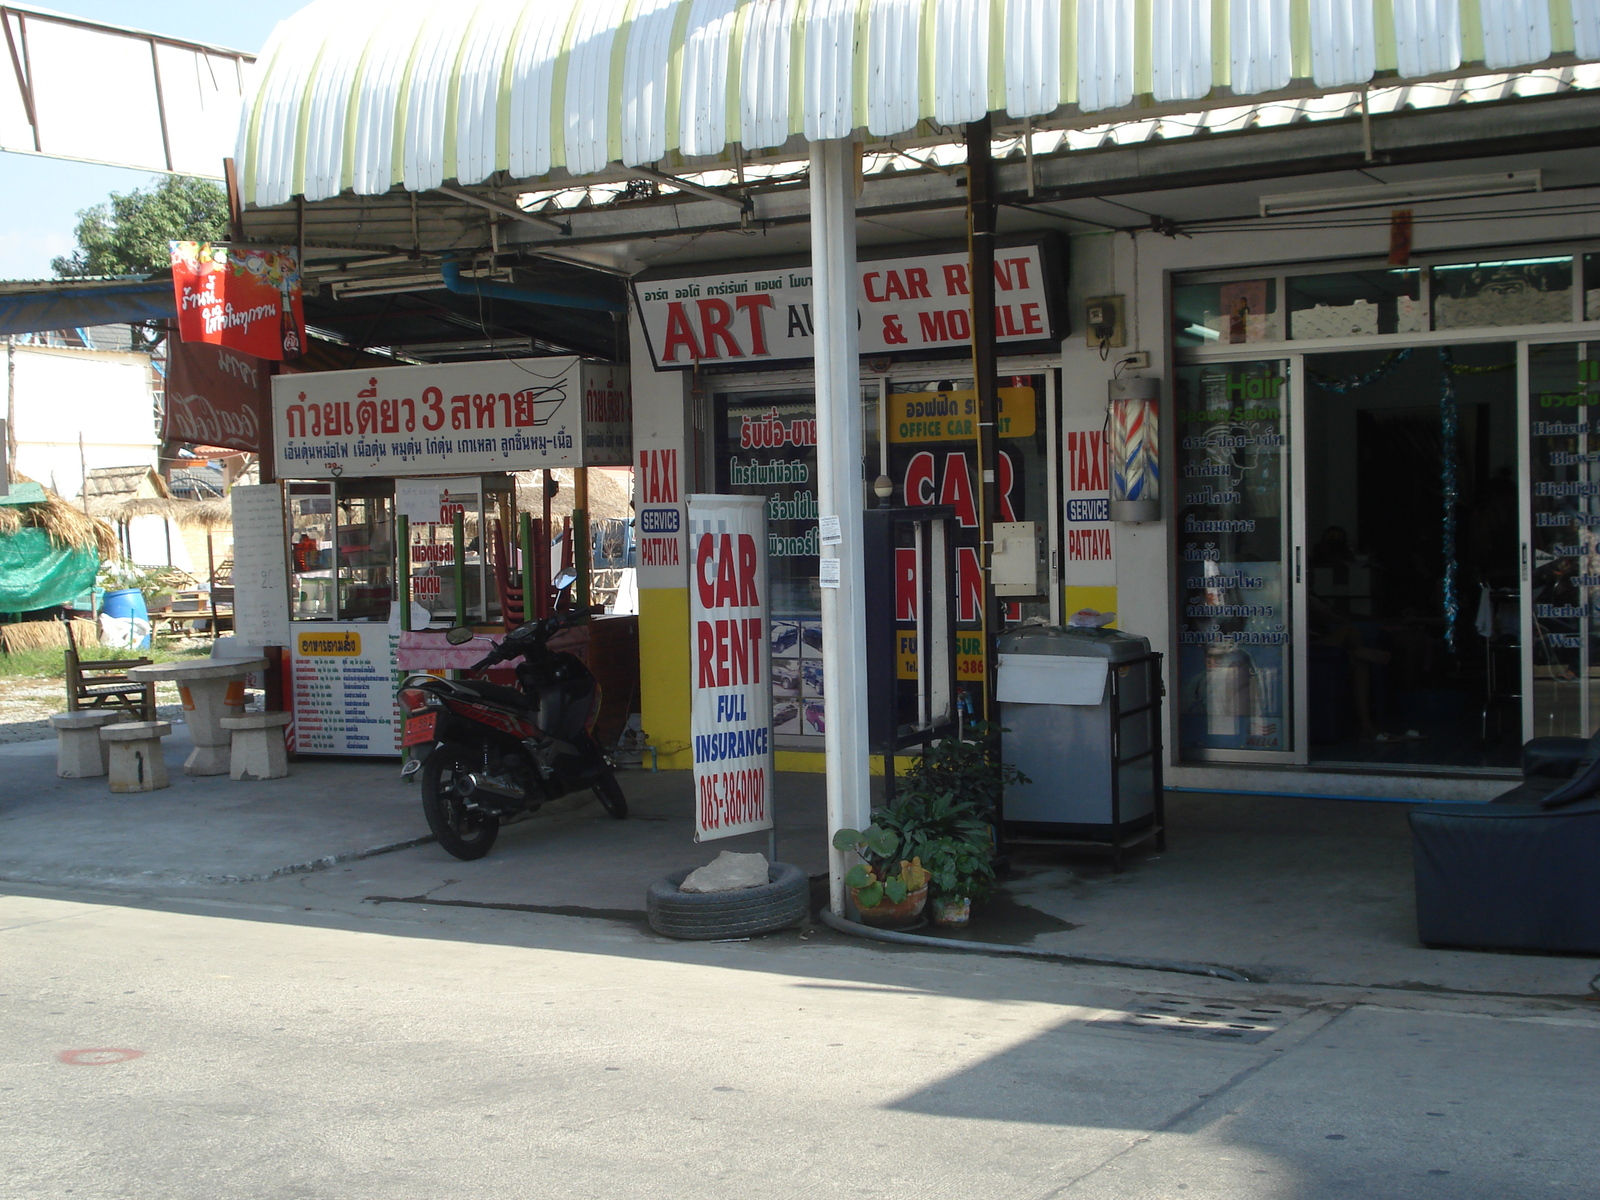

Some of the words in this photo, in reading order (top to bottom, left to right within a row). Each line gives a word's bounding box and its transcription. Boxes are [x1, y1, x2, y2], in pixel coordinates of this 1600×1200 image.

[863, 267, 932, 303] CAR
[942, 257, 1031, 295] RNT
[662, 294, 774, 362] ART
[883, 314, 908, 344] &
[919, 303, 1044, 342] MOILE
[1226, 370, 1284, 400] Hair
[422, 386, 446, 432] 3
[451, 391, 535, 430] สหาย
[1234, 404, 1280, 421] Salon
[899, 421, 941, 438] OFFICE
[947, 419, 972, 435] CAR
[1535, 421, 1590, 435] Haircut
[458, 438, 497, 453] เกาเหลา
[1068, 431, 1109, 491] TAXI
[640, 449, 677, 503] TAXI
[1537, 482, 1600, 499] Highligh
[643, 511, 678, 530] SERVICE
[1070, 500, 1108, 520] SERVICE
[1537, 512, 1570, 527] Hair
[642, 538, 679, 566] PATTAYA
[1069, 529, 1112, 560] PATTAYA
[1554, 543, 1589, 557] Sand
[697, 533, 760, 609] CAR
[1537, 603, 1589, 618] Herbal
[698, 618, 762, 688] RENT
[717, 694, 747, 723] FULL
[696, 728, 768, 763] INSURANCE
[701, 767, 764, 832] 085-3869090
